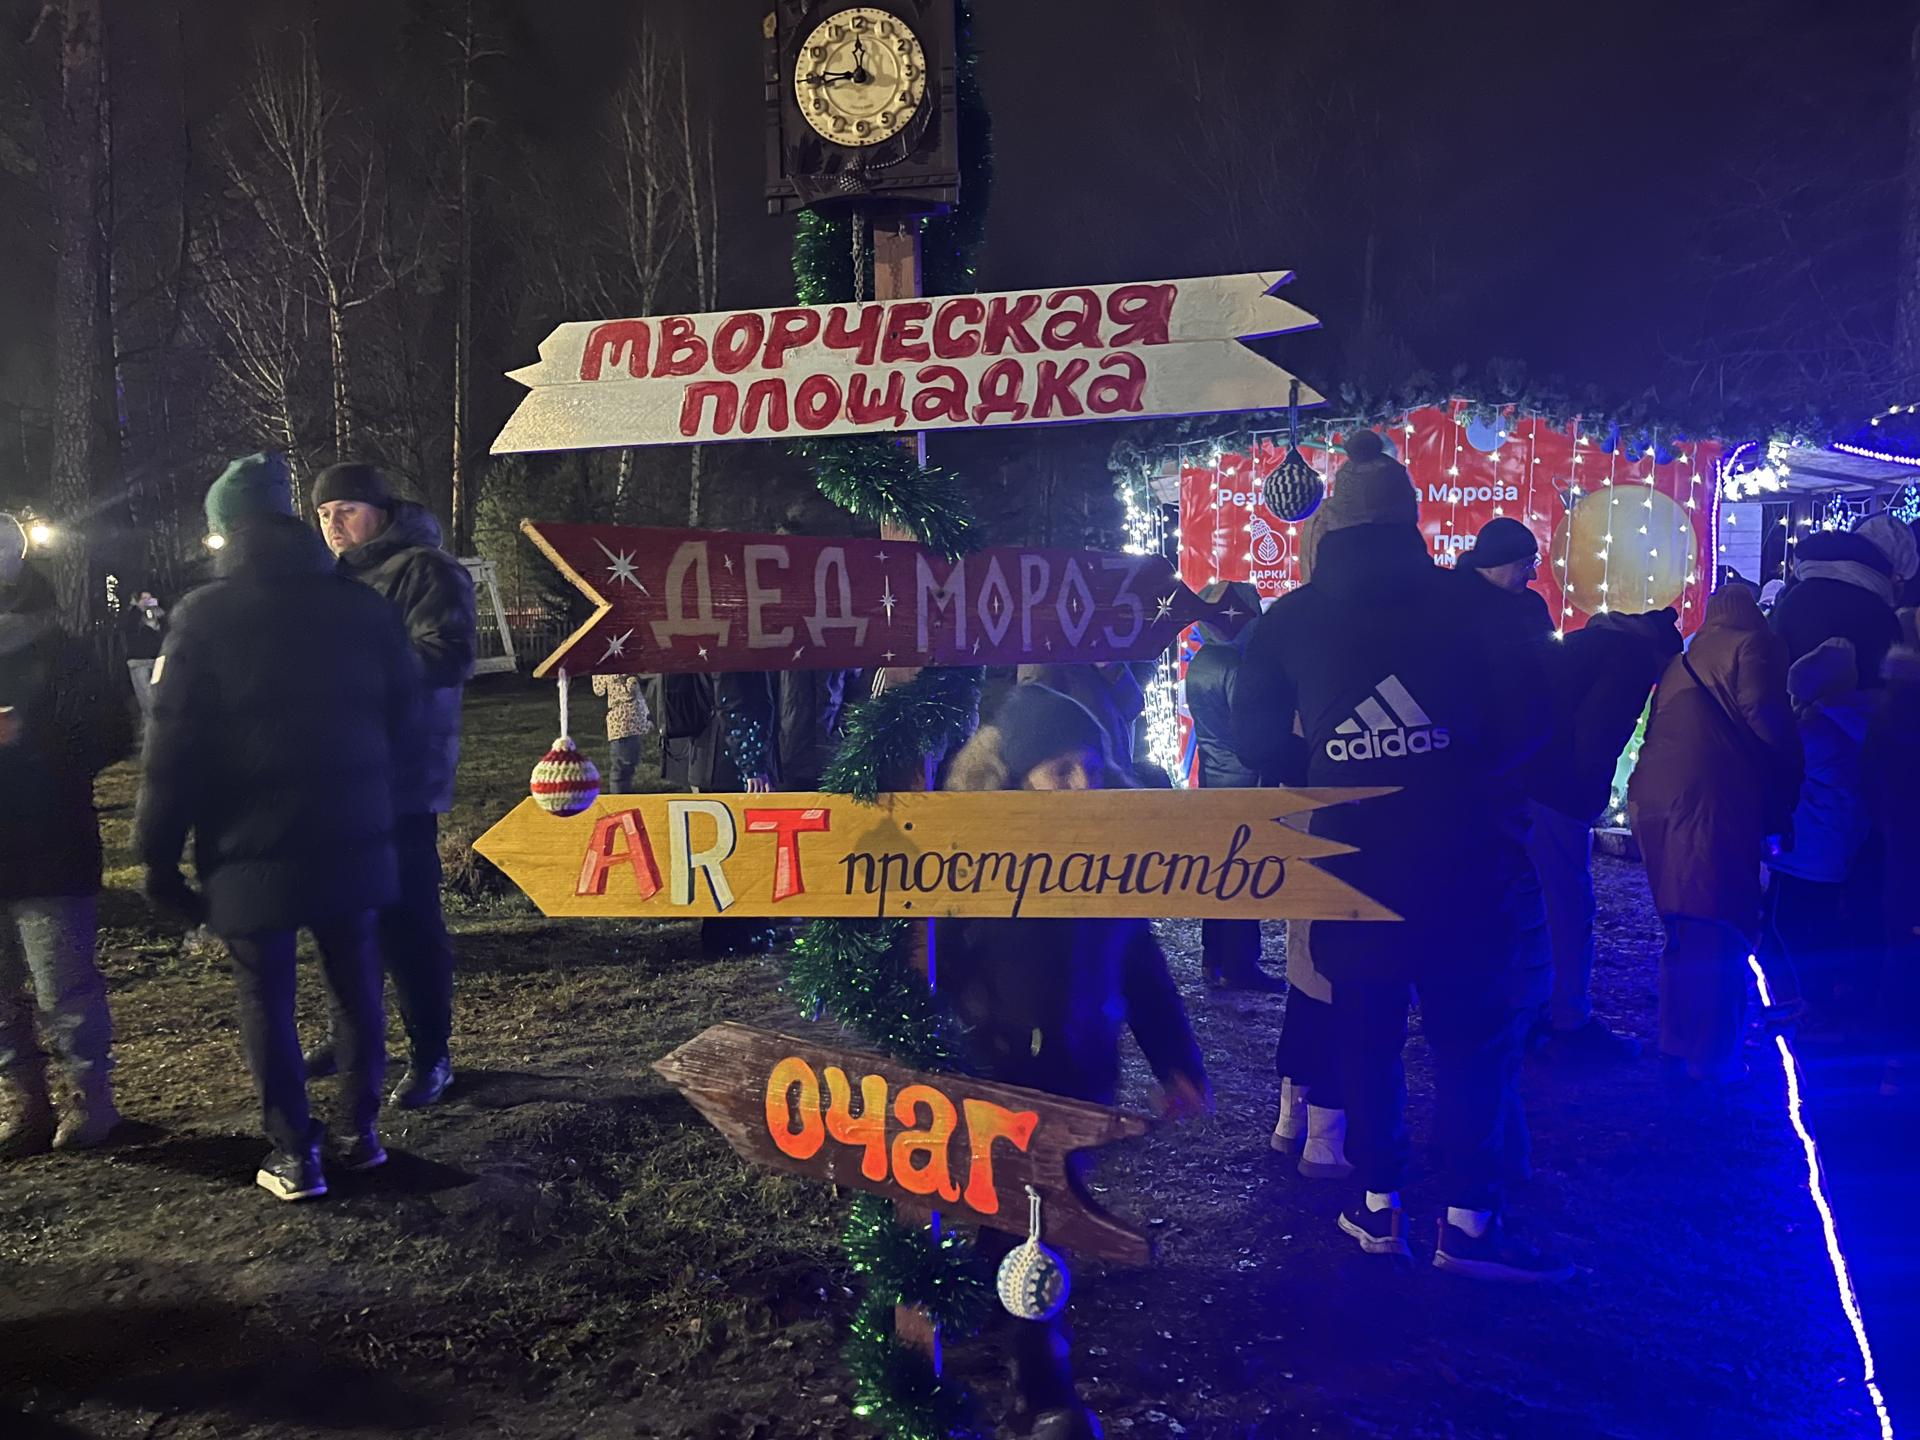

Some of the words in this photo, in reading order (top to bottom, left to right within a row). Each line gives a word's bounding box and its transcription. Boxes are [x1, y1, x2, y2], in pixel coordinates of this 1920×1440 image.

[851, 16, 863, 28] 12
[829, 25, 840, 36] 11
[898, 39, 905, 51] 2
[810, 47, 821, 57] 10
[905, 65, 913, 77] 3
[898, 92, 907, 103] 4
[832, 116, 841, 128] 7
[881, 112, 889, 124] 5
[856, 121, 866, 133] 6
[1428, 483, 1519, 507] Мороза
[1433, 534, 1478, 552] ПАР
[648, 540, 870, 650] ДЕД
[916, 553, 1146, 655] МОРОЗ
[1325, 726, 1451, 761] adidas
[575, 799, 831, 913] ART
[838, 823, 1288, 917] пространство
